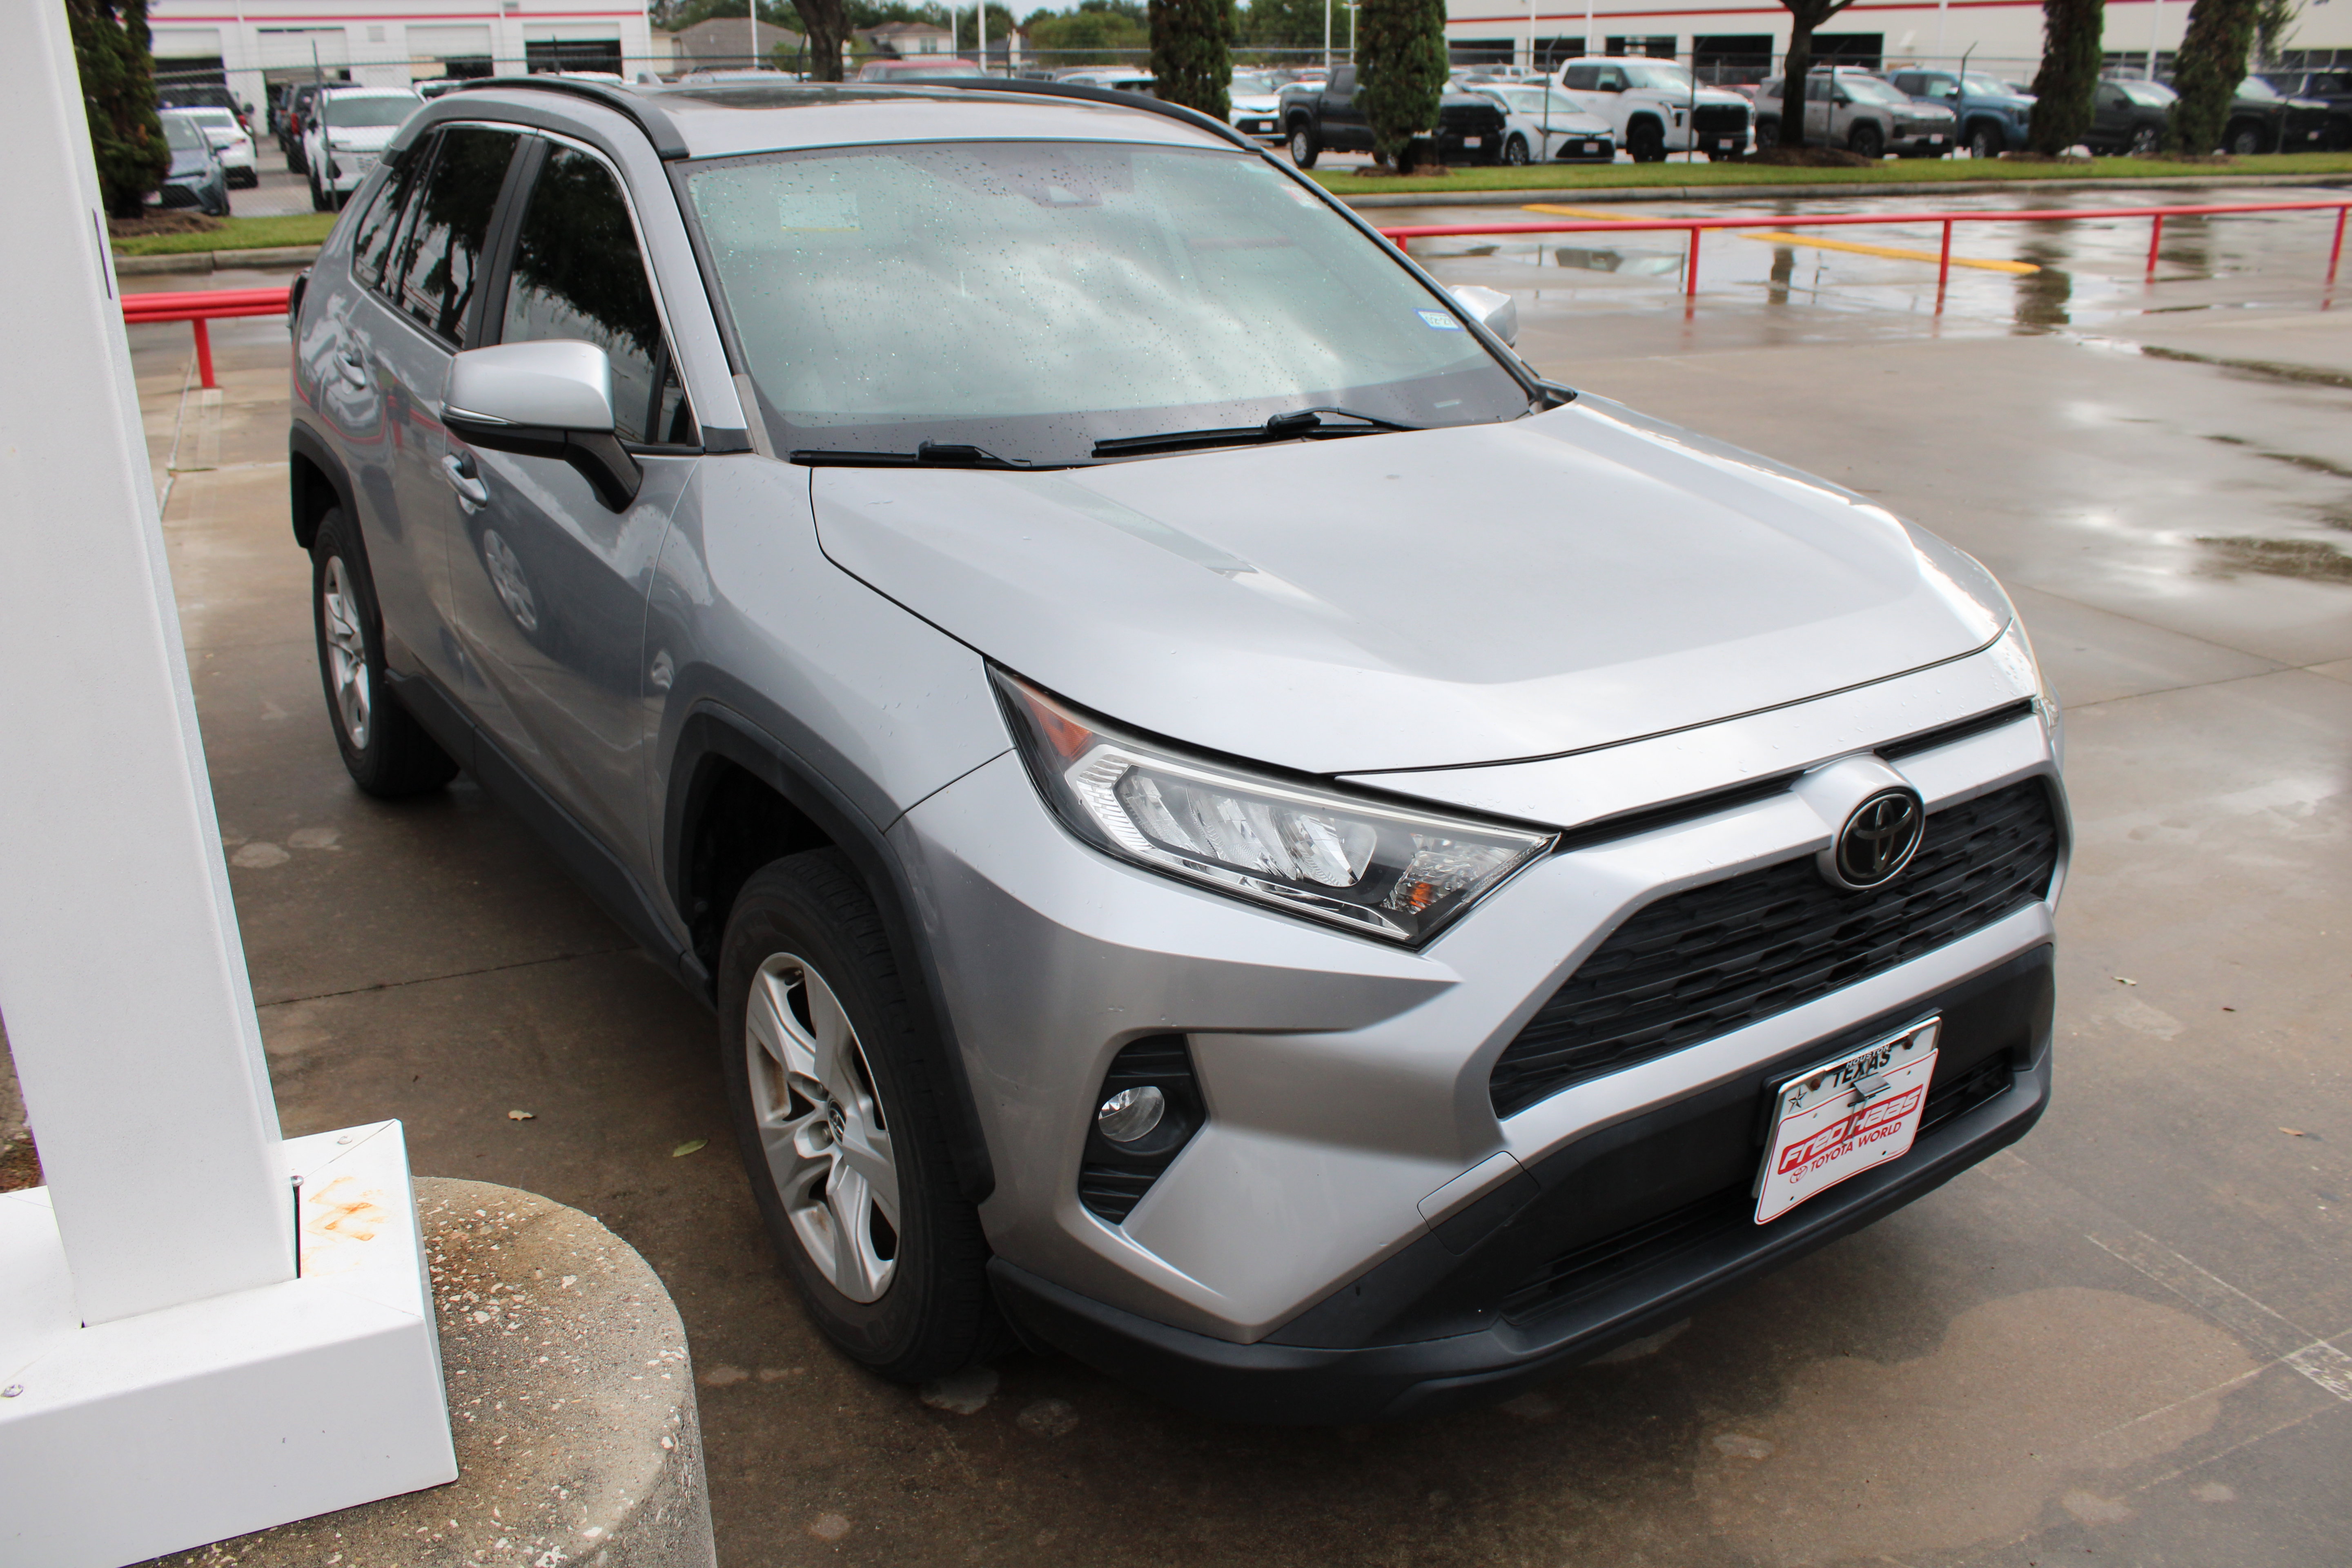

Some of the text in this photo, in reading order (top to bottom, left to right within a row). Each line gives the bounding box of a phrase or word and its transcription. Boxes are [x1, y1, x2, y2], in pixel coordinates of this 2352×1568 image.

[1833, 1049, 1891, 1088] TEXAS
[1846, 1044, 1891, 1068] HOUSTON
[1811, 1122, 1902, 1172] TOYOTA WORLD
